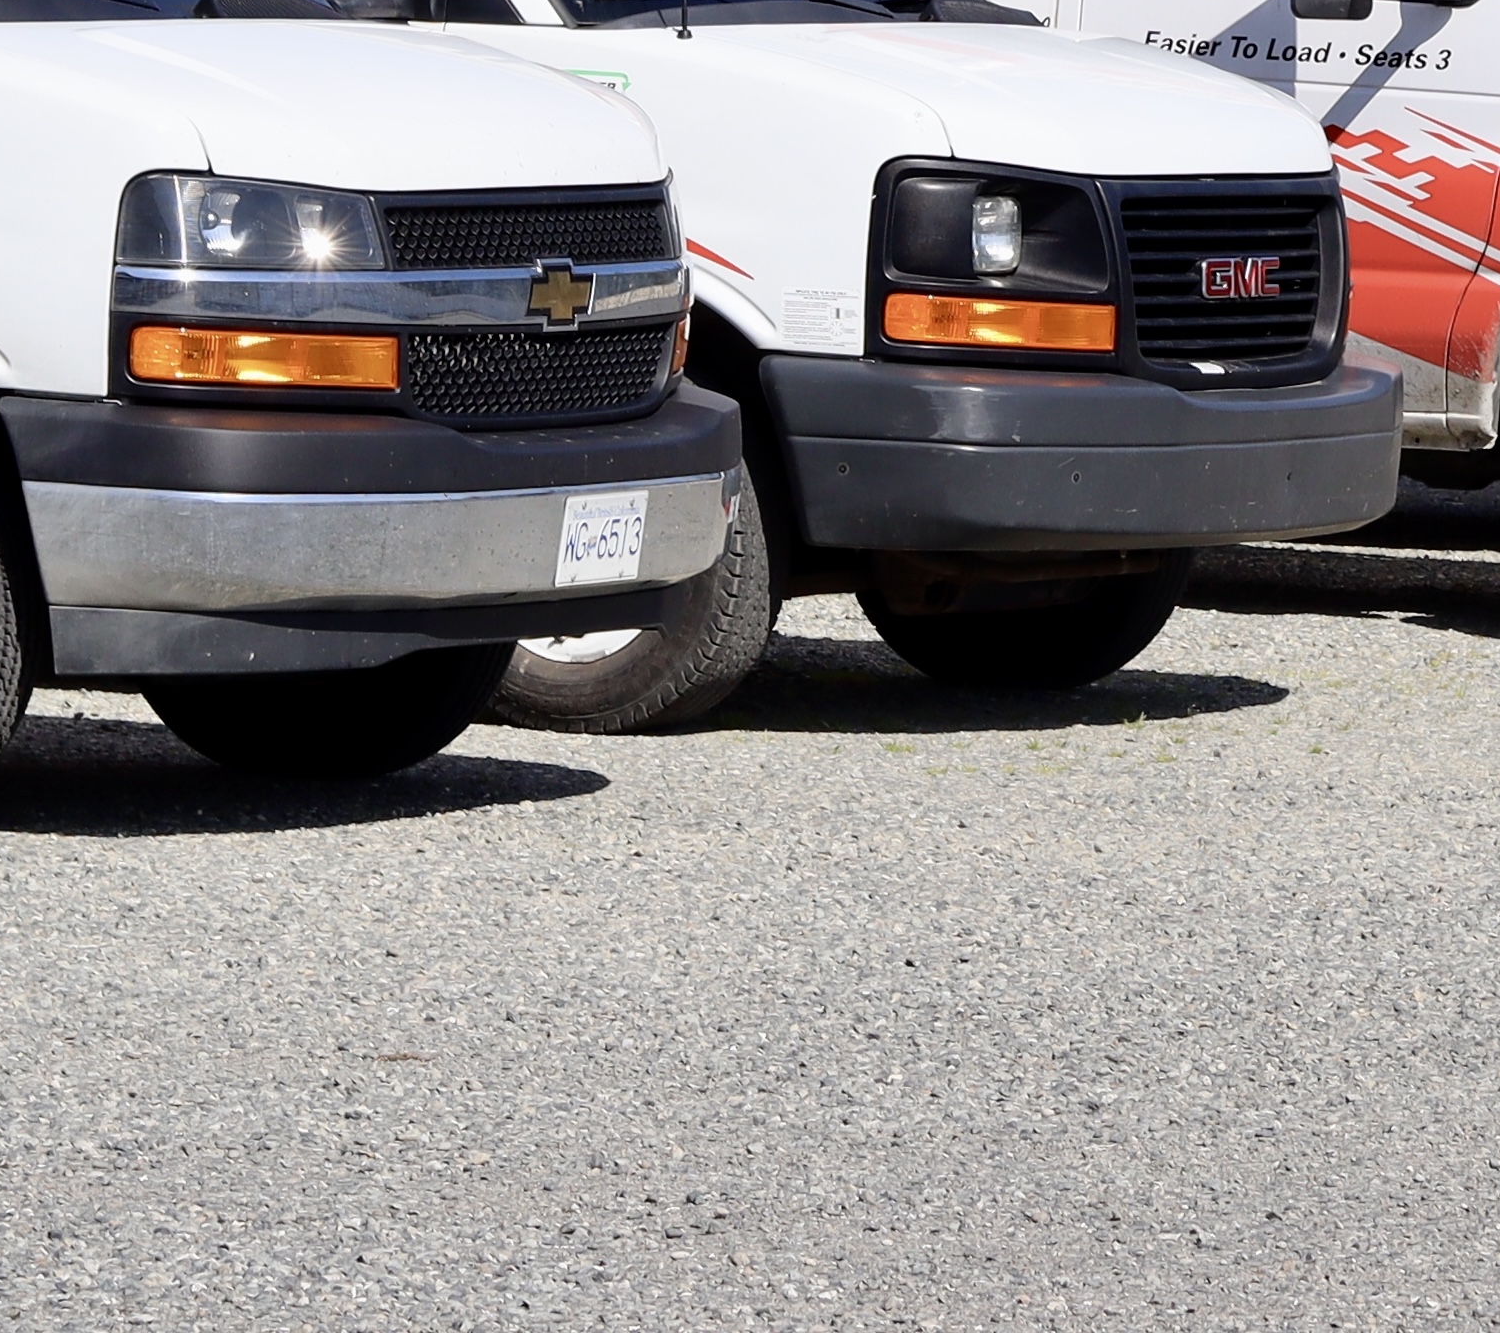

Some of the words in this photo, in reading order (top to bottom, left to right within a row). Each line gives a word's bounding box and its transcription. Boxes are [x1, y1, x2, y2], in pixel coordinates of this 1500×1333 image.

[1144, 30, 1221, 57] Easier
[1231, 35, 1258, 58] To
[1266, 38, 1332, 63] Load
[1354, 44, 1428, 69] Seats
[1435, 49, 1452, 70] 3
[1201, 256, 1281, 300] GMC
